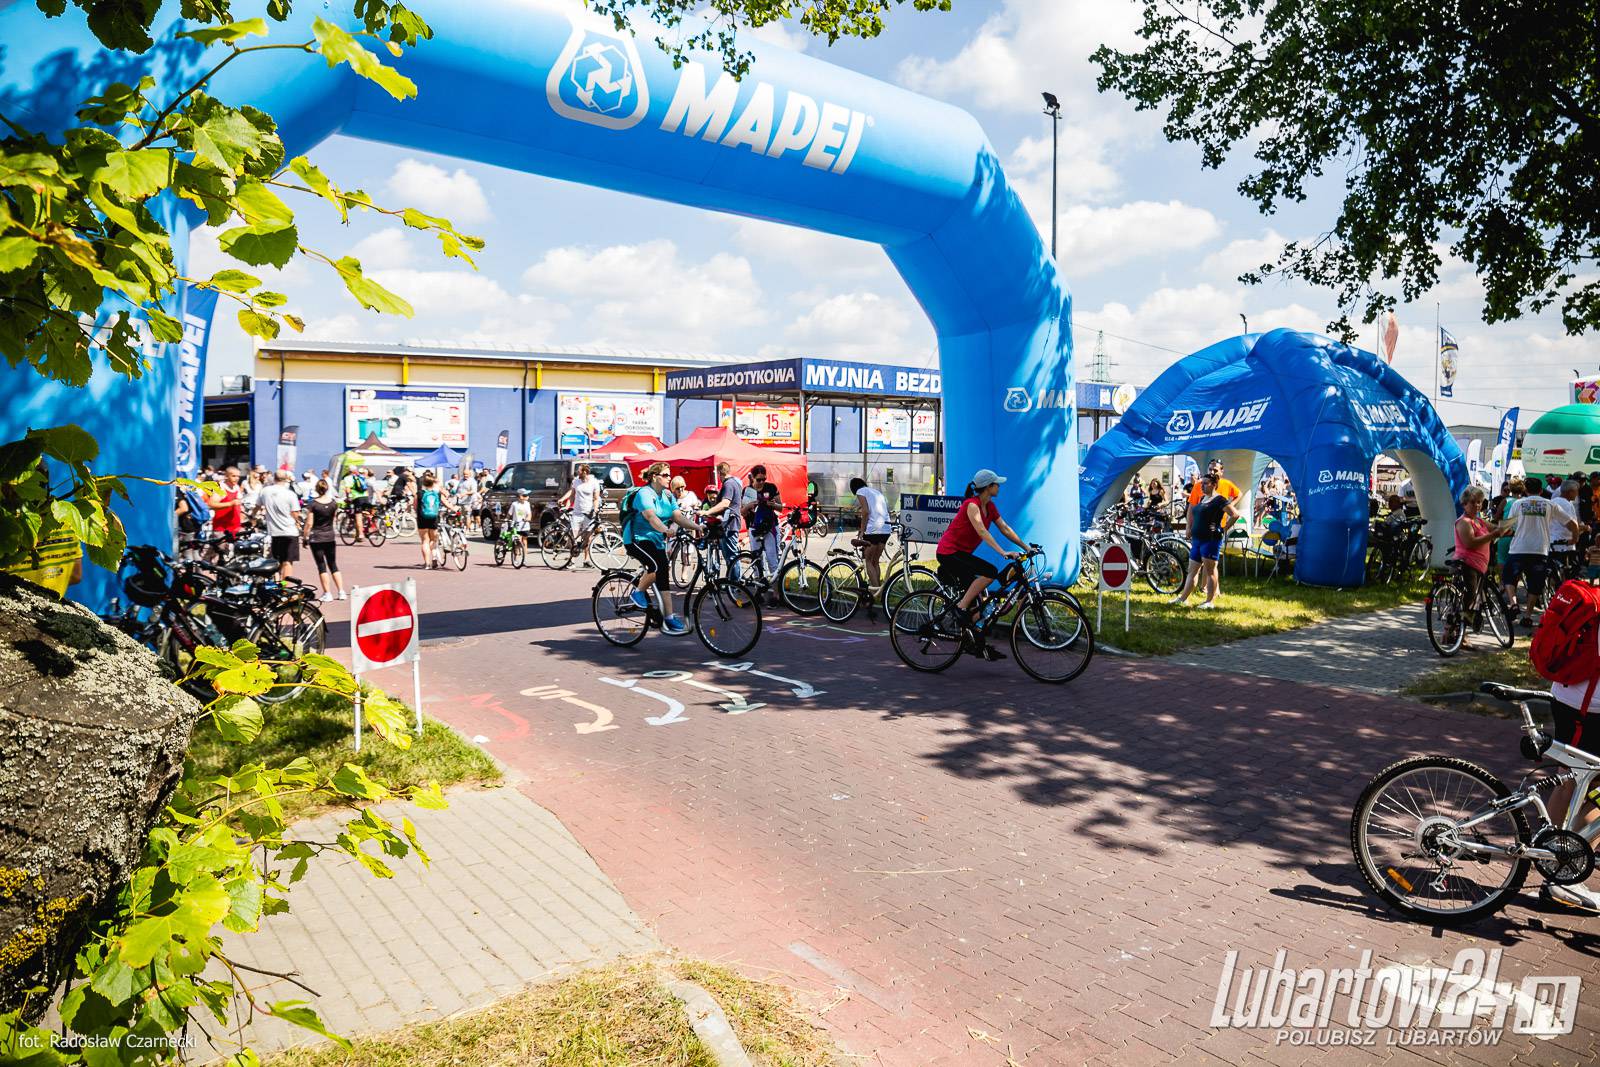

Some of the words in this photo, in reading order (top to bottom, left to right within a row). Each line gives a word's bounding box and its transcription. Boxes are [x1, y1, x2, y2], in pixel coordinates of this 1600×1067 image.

[659, 60, 867, 176] MAPEI
[667, 376, 704, 391] MYJNIA
[707, 367, 796, 388] BEZDOTYKOWA
[805, 364, 885, 390] MYJNIA
[895, 372, 941, 393] BEZD
[766, 413, 779, 430] 15
[1197, 401, 1269, 432] MAPEI
[927, 497, 963, 510] MRÓWKA
